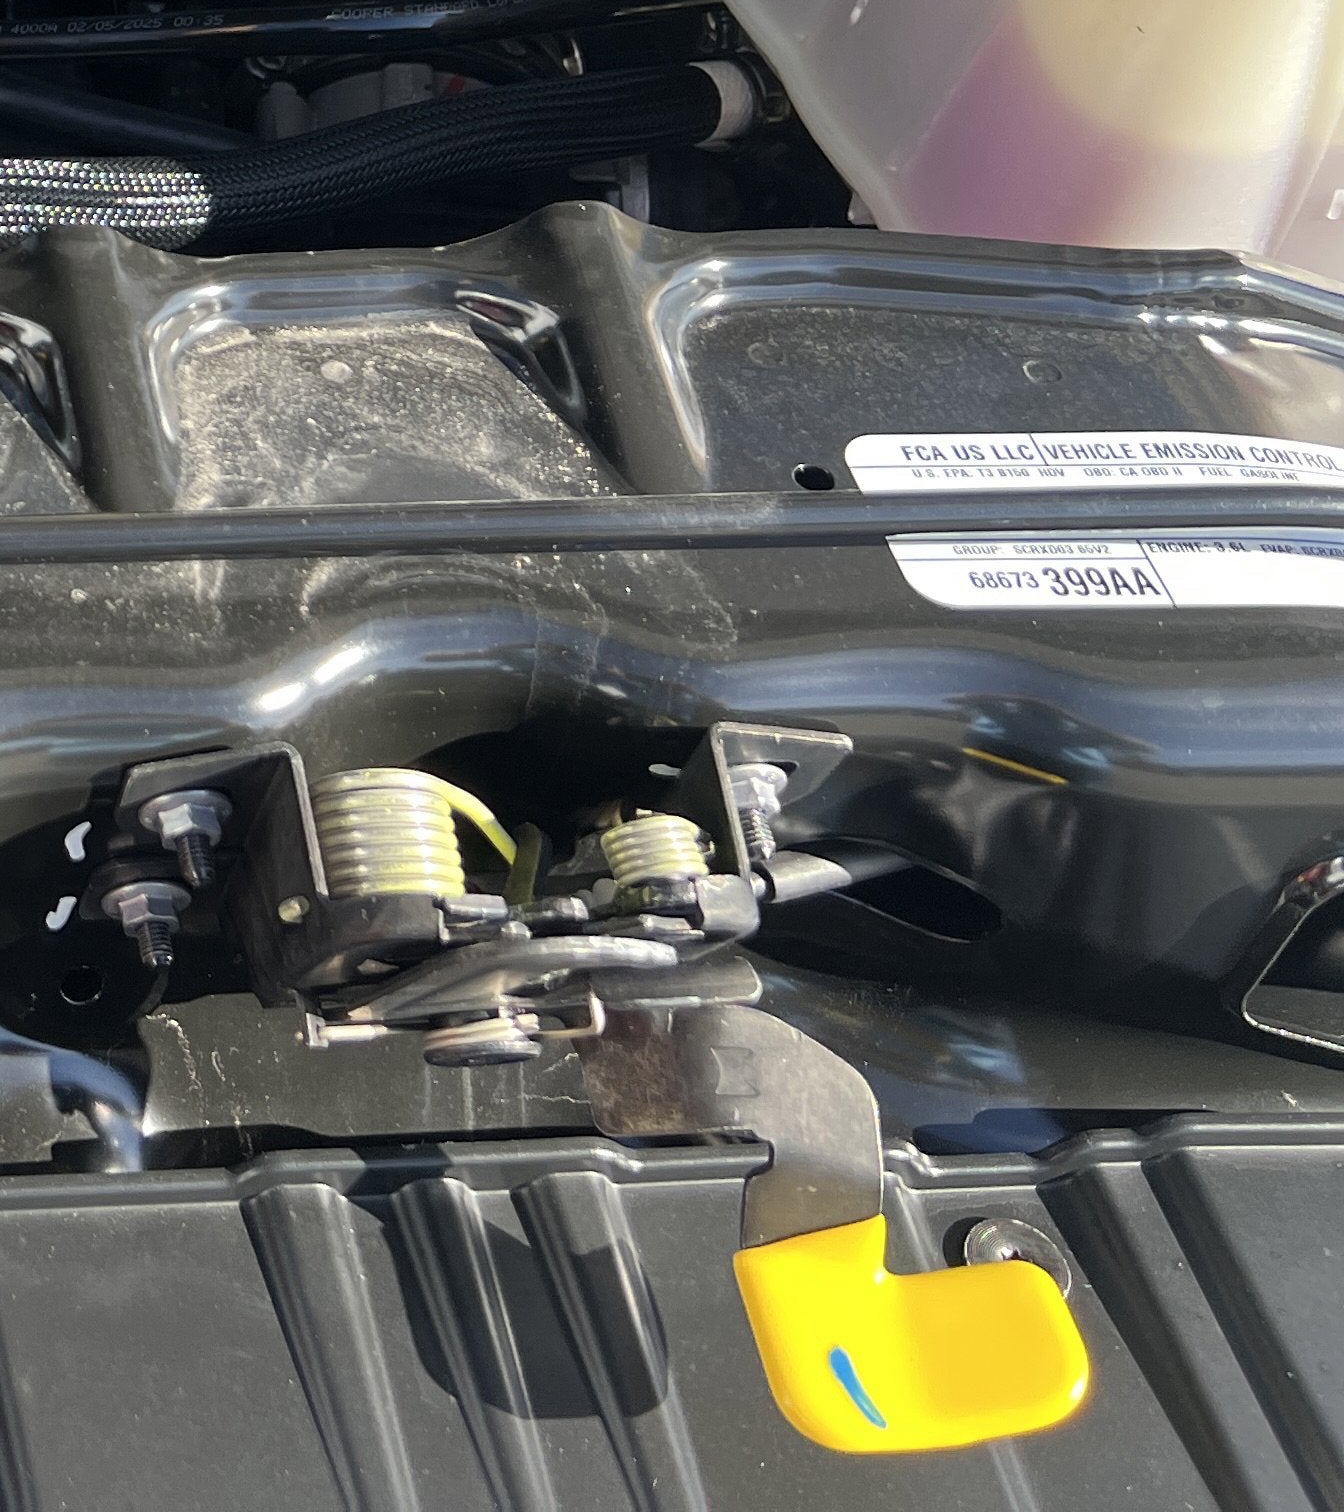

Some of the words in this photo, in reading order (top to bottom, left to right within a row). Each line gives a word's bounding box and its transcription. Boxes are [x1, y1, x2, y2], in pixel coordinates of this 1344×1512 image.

[900, 444, 948, 461] FCA
[950, 444, 986, 461] US
[989, 444, 1035, 460] LLC
[1042, 442, 1137, 460] VEHICLE
[1140, 442, 1246, 461] EMISSION
[1249, 445, 1344, 473] CONTROL
[911, 467, 940, 478] U.S.
[978, 468, 995, 478] T3
[1119, 467, 1138, 477] CA
[1140, 467, 1170, 477] OBD
[1146, 541, 1212, 553] ENGINE:
[1213, 541, 1248, 553] 3.6L
[968, 571, 1040, 589] 68673
[1042, 566, 1162, 597] 399AA
